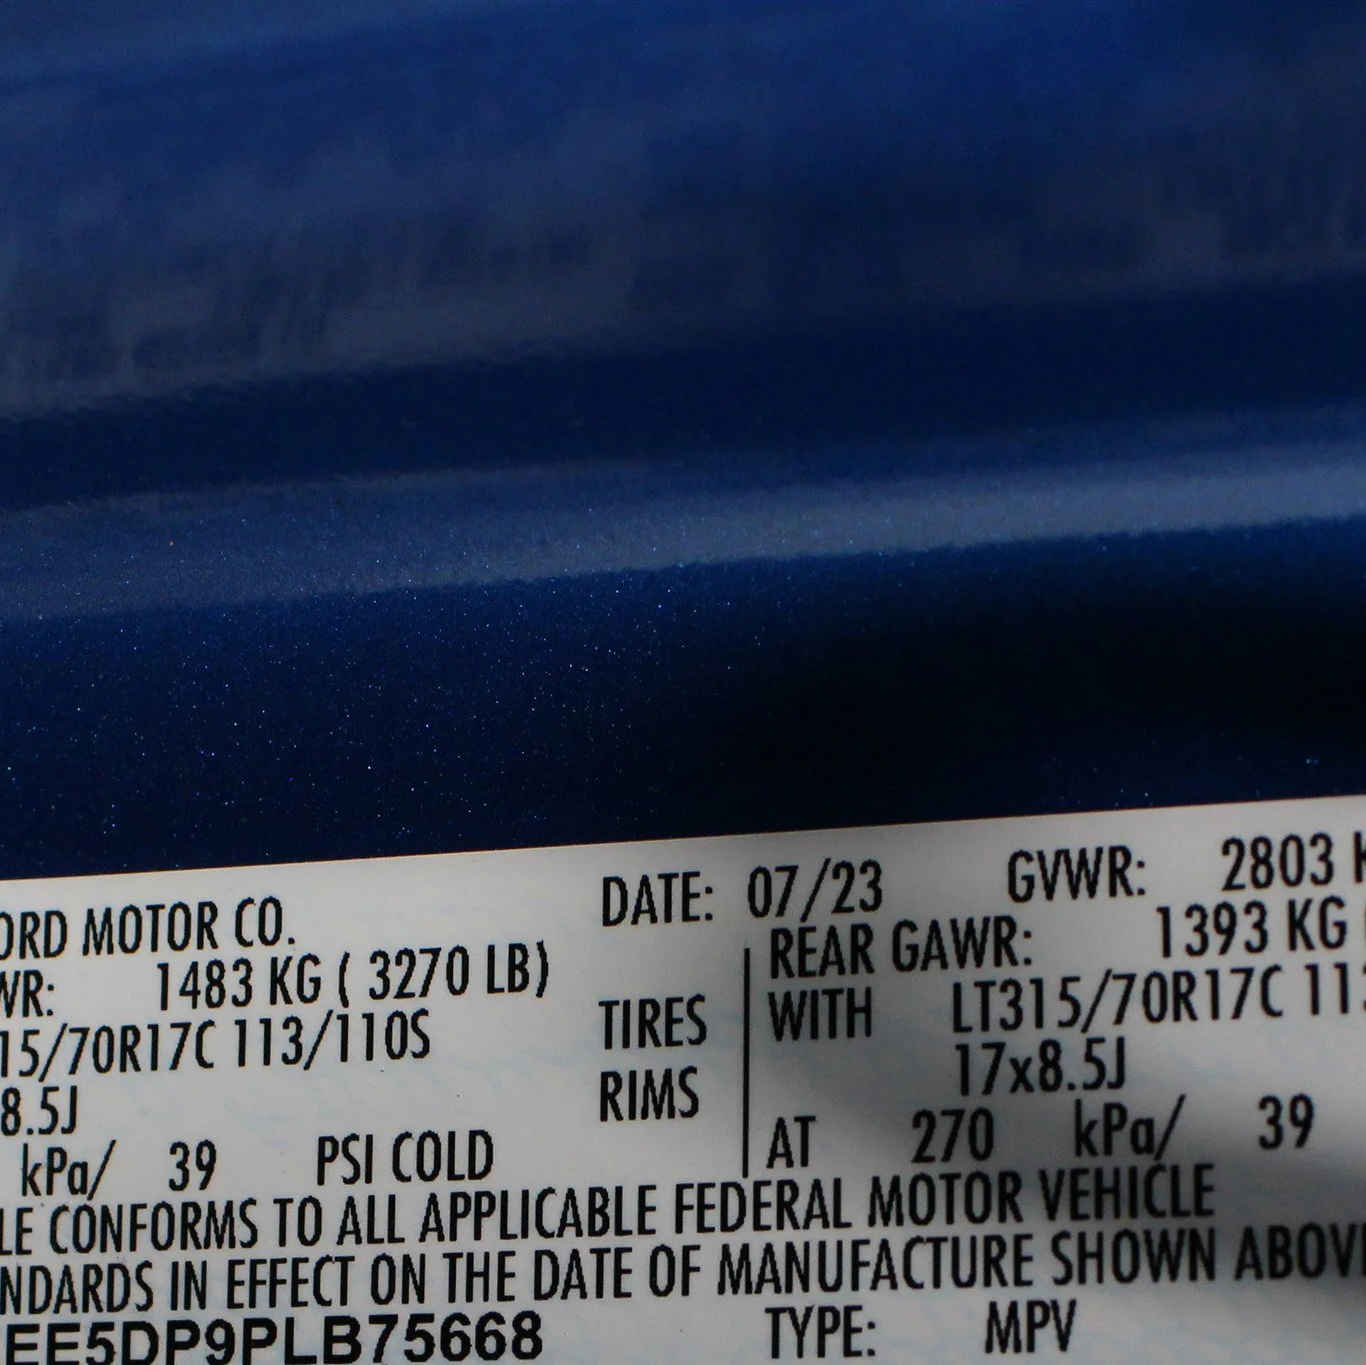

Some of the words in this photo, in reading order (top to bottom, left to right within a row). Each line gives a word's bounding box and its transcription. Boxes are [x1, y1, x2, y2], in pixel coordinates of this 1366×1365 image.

[602, 871, 713, 926] DATE:
[748, 858, 882, 923] 07/23
[1008, 846, 1145, 903] GVWR:
[1222, 833, 1334, 891] 2803
[83, 902, 218, 956] MOTOR
[235, 897, 295, 947] CO.
[770, 923, 875, 979] REAR
[892, 916, 1031, 972] GAWR:
[1157, 901, 1268, 958] 1393
[1288, 896, 1347, 951] KG
[157, 958, 253, 1011] 1483
[270, 954, 321, 1005] KG
[369, 946, 469, 1000] 3270
[487, 941, 549, 998] LB)
[768, 986, 872, 1042] WITH
[953, 965, 1282, 1033] LT315/70R17C
[235, 1008, 430, 1070] 113/110S
[599, 994, 707, 1050] TIRES
[600, 1066, 699, 1121] RIMS
[955, 1037, 1125, 1097] 17x8.5J
[22, 1140, 116, 1201] kPa/
[169, 1140, 216, 1191] 39
[317, 1133, 373, 1186] PSI
[392, 1130, 493, 1182] COLD
[766, 1116, 816, 1169] AT
[912, 1107, 994, 1163] 270
[1073, 1095, 1185, 1162] kPa/
[1259, 1094, 1314, 1150] 39
[50, 1198, 258, 1254] CONFORMS
[273, 1196, 322, 1247] TO
[337, 1194, 405, 1245] ALL
[419, 1185, 656, 1242] APPLICABLE
[675, 1178, 852, 1234] FEDERAL
[868, 1170, 1023, 1227] MOTOR
[1038, 1163, 1215, 1221] VEHICLE
[171, 1260, 207, 1311] IN
[227, 1255, 355, 1309] EFFECT
[371, 1253, 425, 1305] ON
[443, 1251, 516, 1303] THE
[534, 1247, 632, 1301] DATE
[649, 1244, 701, 1297] OF
[717, 1234, 1033, 1295] MANUFACTURE
[1051, 1227, 1216, 1286] SHOWN
[765, 1305, 875, 1359] TYPE:
[985, 1299, 1076, 1354] MPV
